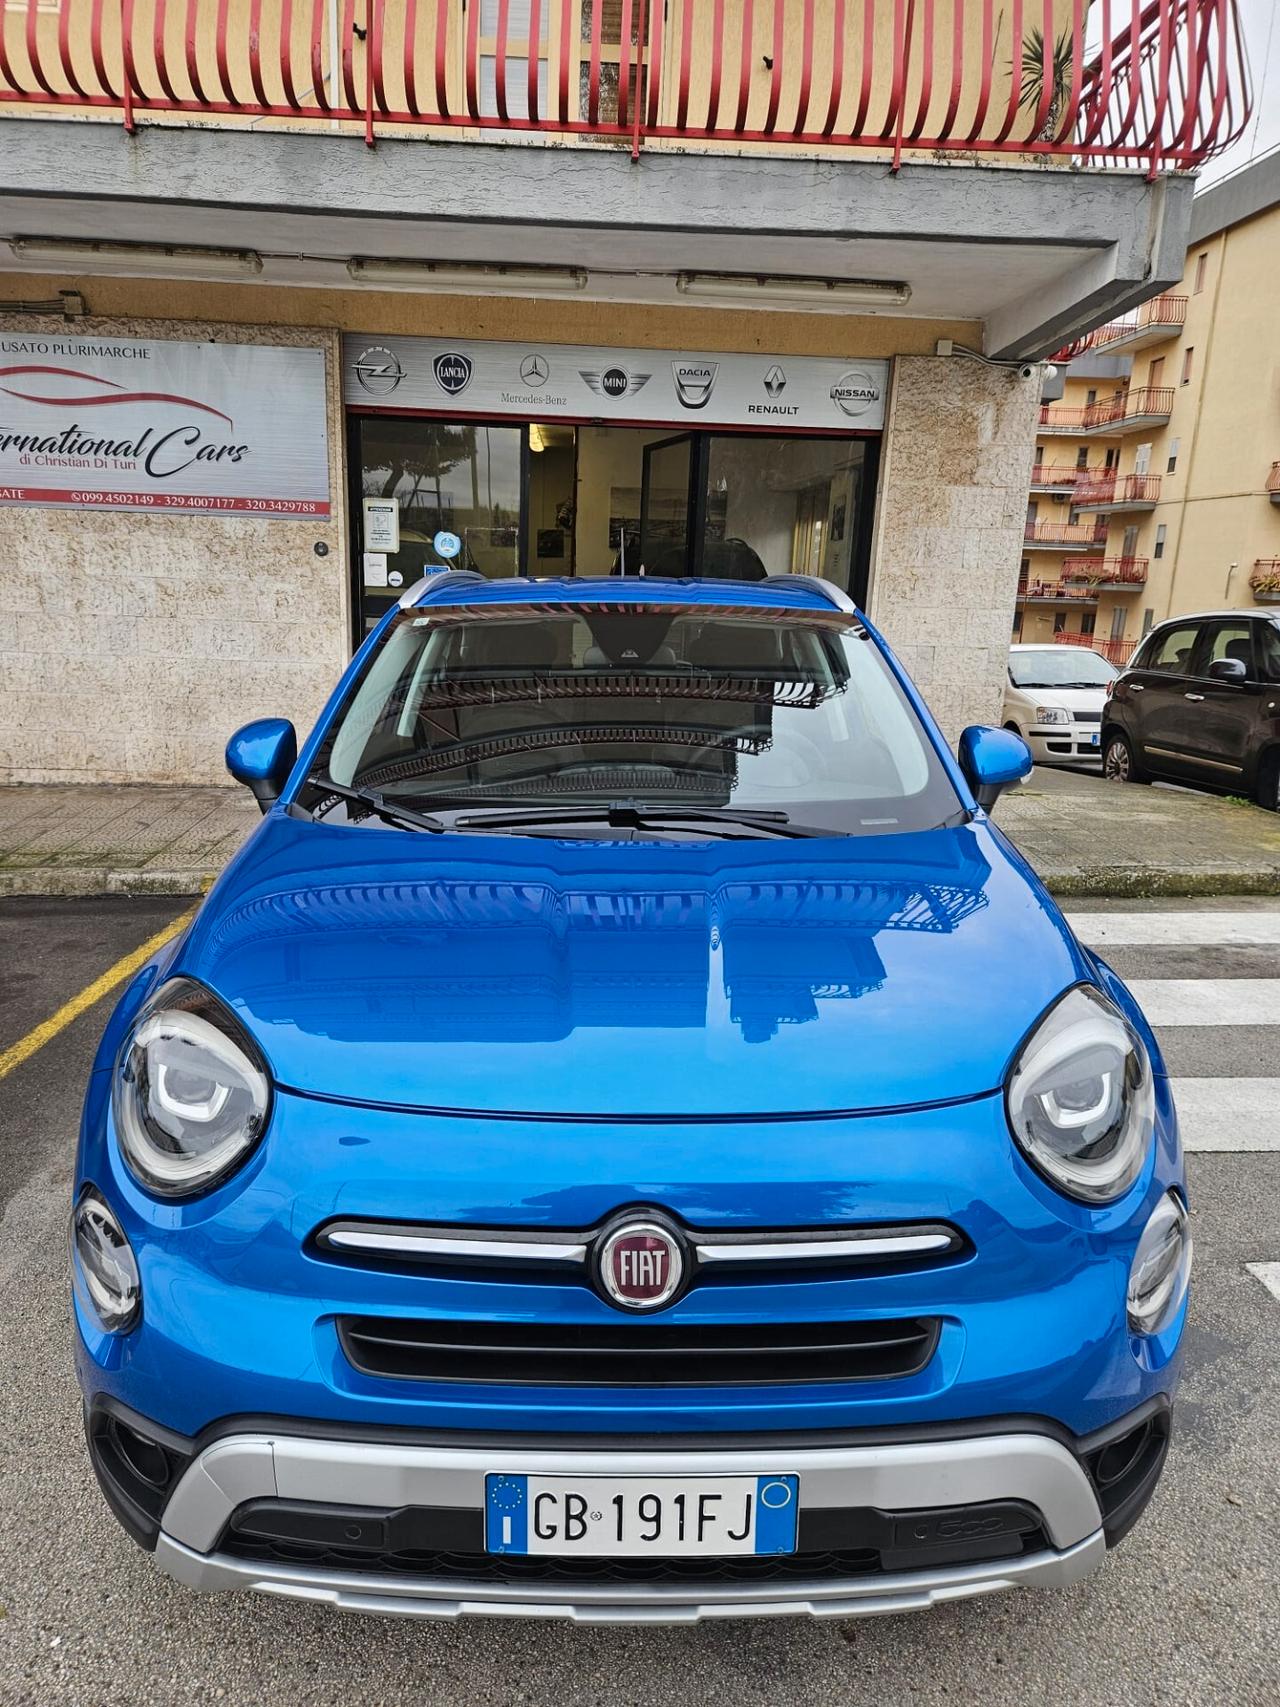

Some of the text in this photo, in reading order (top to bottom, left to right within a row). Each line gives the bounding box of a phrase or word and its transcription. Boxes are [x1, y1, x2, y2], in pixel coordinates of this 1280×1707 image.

[1, 341, 151, 359] USATO PLURIMARCHE
[440, 366, 466, 378] LANCIA
[678, 367, 711, 377] DACIA
[603, 377, 627, 388] MINI
[501, 392, 567, 406] Mercedes-Benz
[834, 388, 875, 399] NISSAN
[748, 404, 799, 415] RENAULT
[145, 426, 252, 477] Cars
[20, 454, 136, 470] di Christian Di Turi
[82, 492, 154, 504] 099.4502149
[164, 496, 235, 508] 329.4007177
[246, 500, 316, 512] 320.3429788
[620, 1250, 666, 1286] FIAT
[534, 1492, 588, 1541] GB
[612, 1493, 753, 1542] 191FJ
